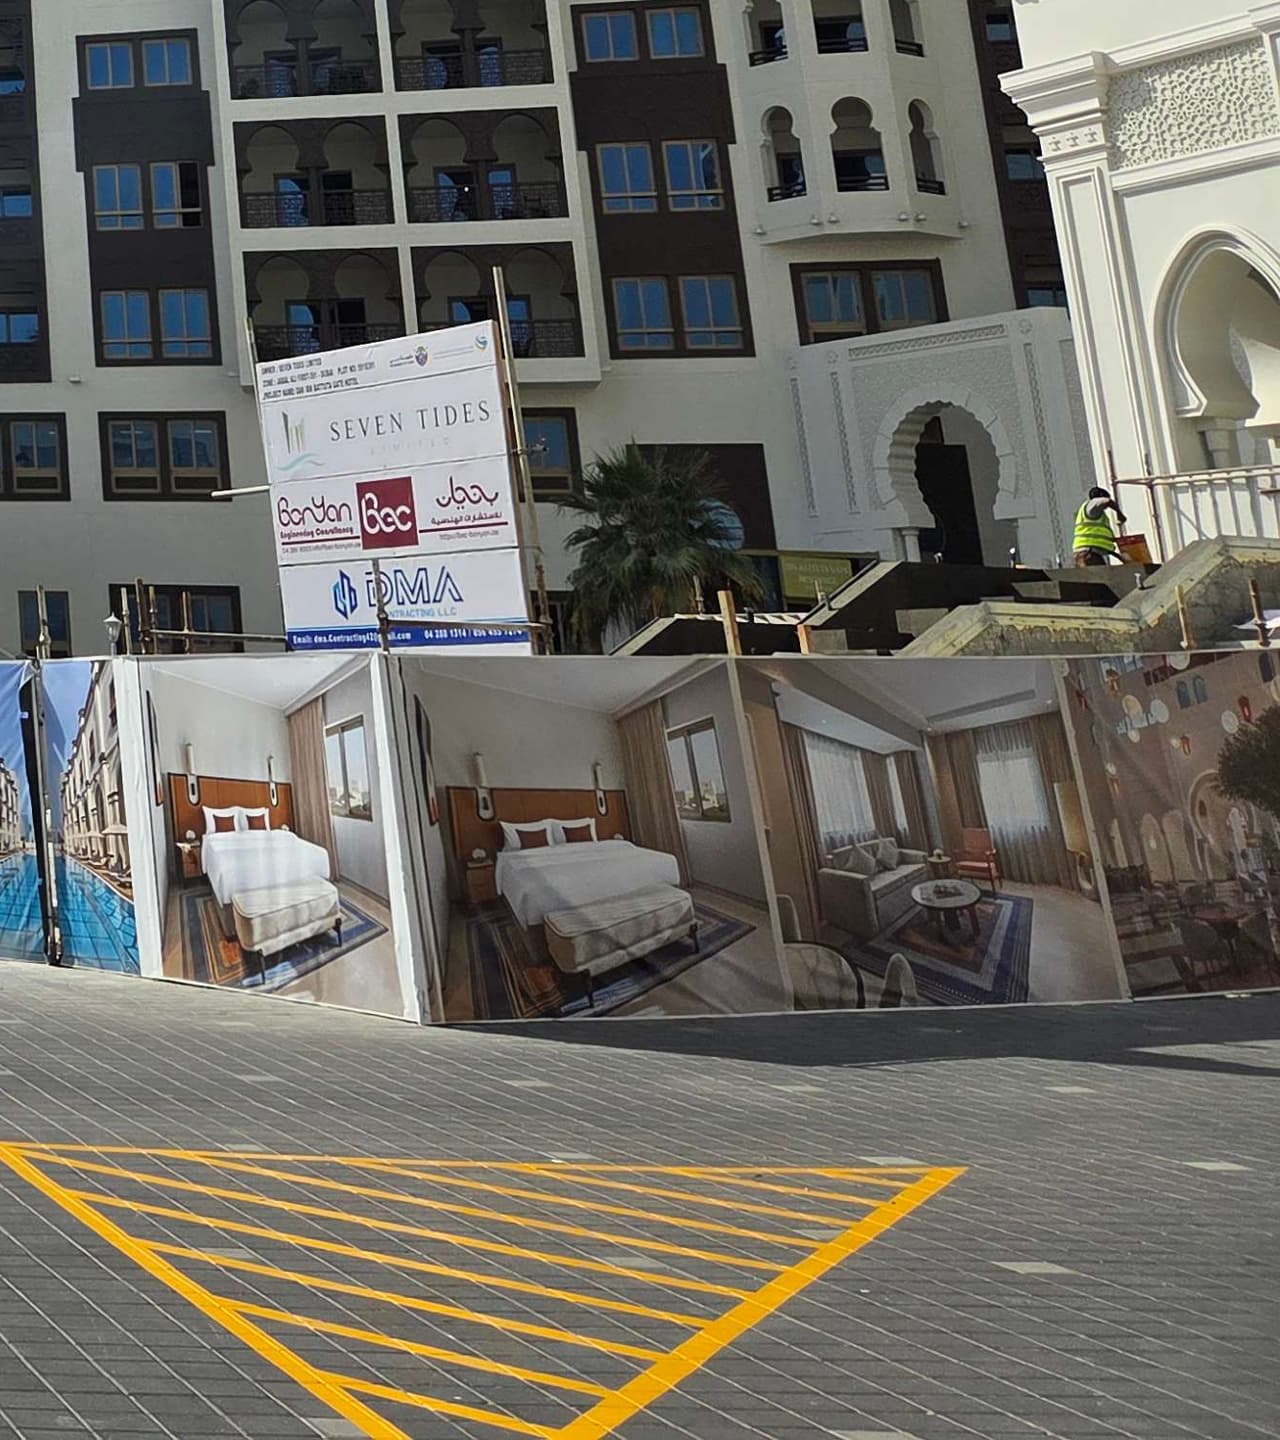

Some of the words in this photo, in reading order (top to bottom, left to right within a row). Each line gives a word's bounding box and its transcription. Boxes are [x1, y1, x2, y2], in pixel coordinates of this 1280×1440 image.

[329, 412, 403, 441] SEVEN
[416, 400, 490, 430] TIDES
[365, 565, 464, 608] DMA
